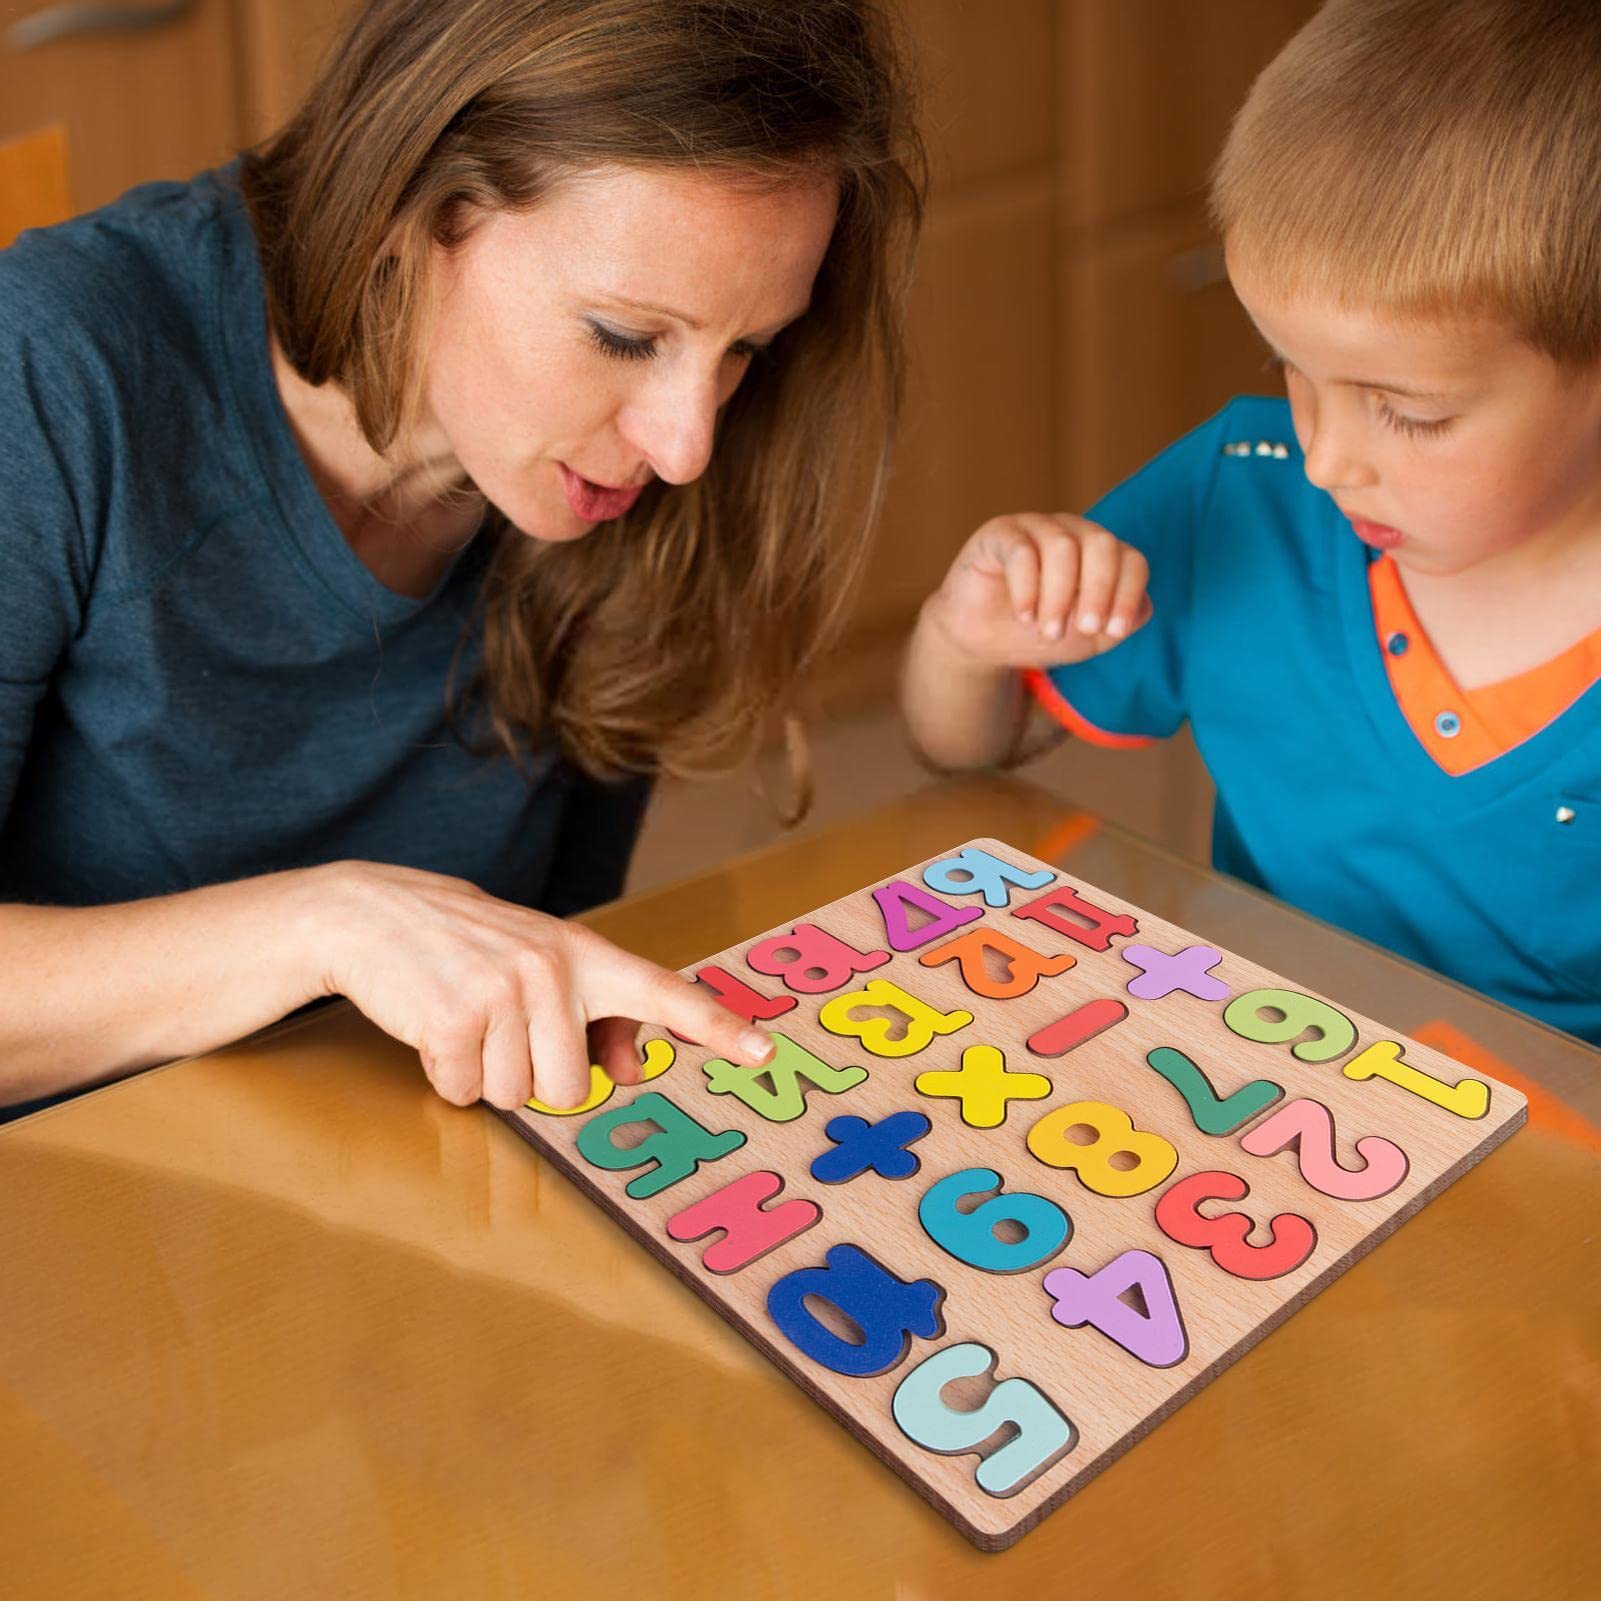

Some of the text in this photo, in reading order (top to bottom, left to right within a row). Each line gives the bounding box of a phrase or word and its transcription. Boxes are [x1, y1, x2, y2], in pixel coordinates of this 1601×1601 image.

[873, 881, 983, 952] 17
[923, 849, 1055, 906] 16
[1012, 887, 1138, 950] 11
[747, 923, 892, 993] 18
[920, 928, 1076, 999] 12
[819, 979, 973, 1057] 13
[1224, 989, 1356, 1061] 6
[703, 1032, 867, 1122] 14
[1147, 1047, 1283, 1134] 7
[577, 1092, 746, 1199] 15
[1027, 1102, 1178, 1197] 8
[919, 1168, 1071, 1273] 9
[893, 1041, 1491, 1496] 1 2 3 4 5
